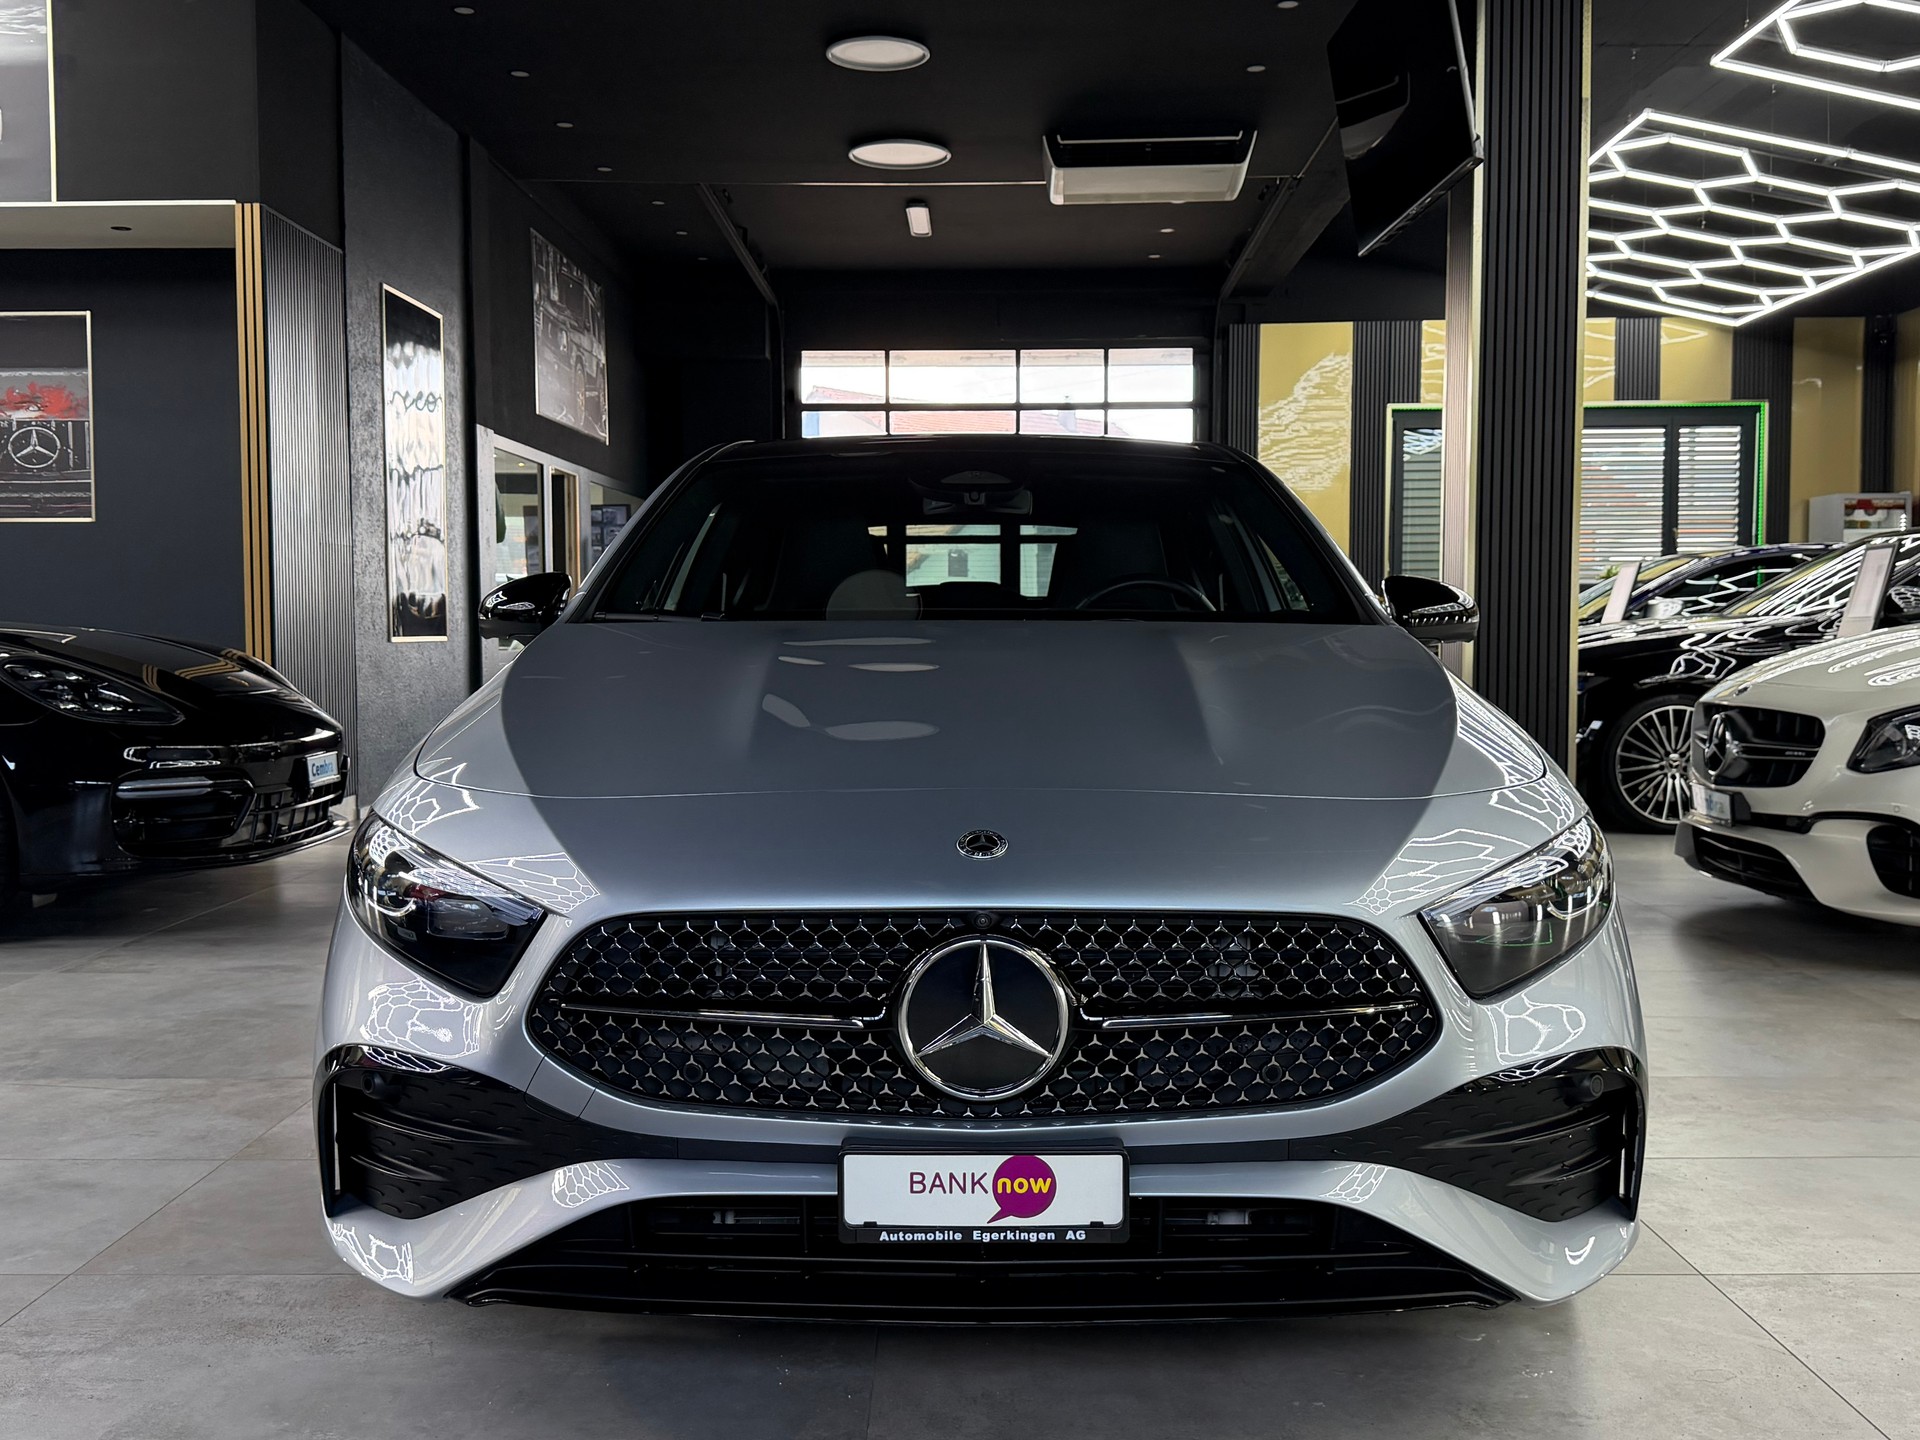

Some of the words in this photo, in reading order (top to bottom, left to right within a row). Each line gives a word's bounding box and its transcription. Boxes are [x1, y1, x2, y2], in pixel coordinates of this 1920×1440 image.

[909, 1171, 989, 1195] BANK
[997, 1177, 1052, 1194] now
[879, 1230, 963, 1241] Automobile
[972, 1230, 1056, 1243] Egerkingen
[1065, 1230, 1086, 1241] AG
